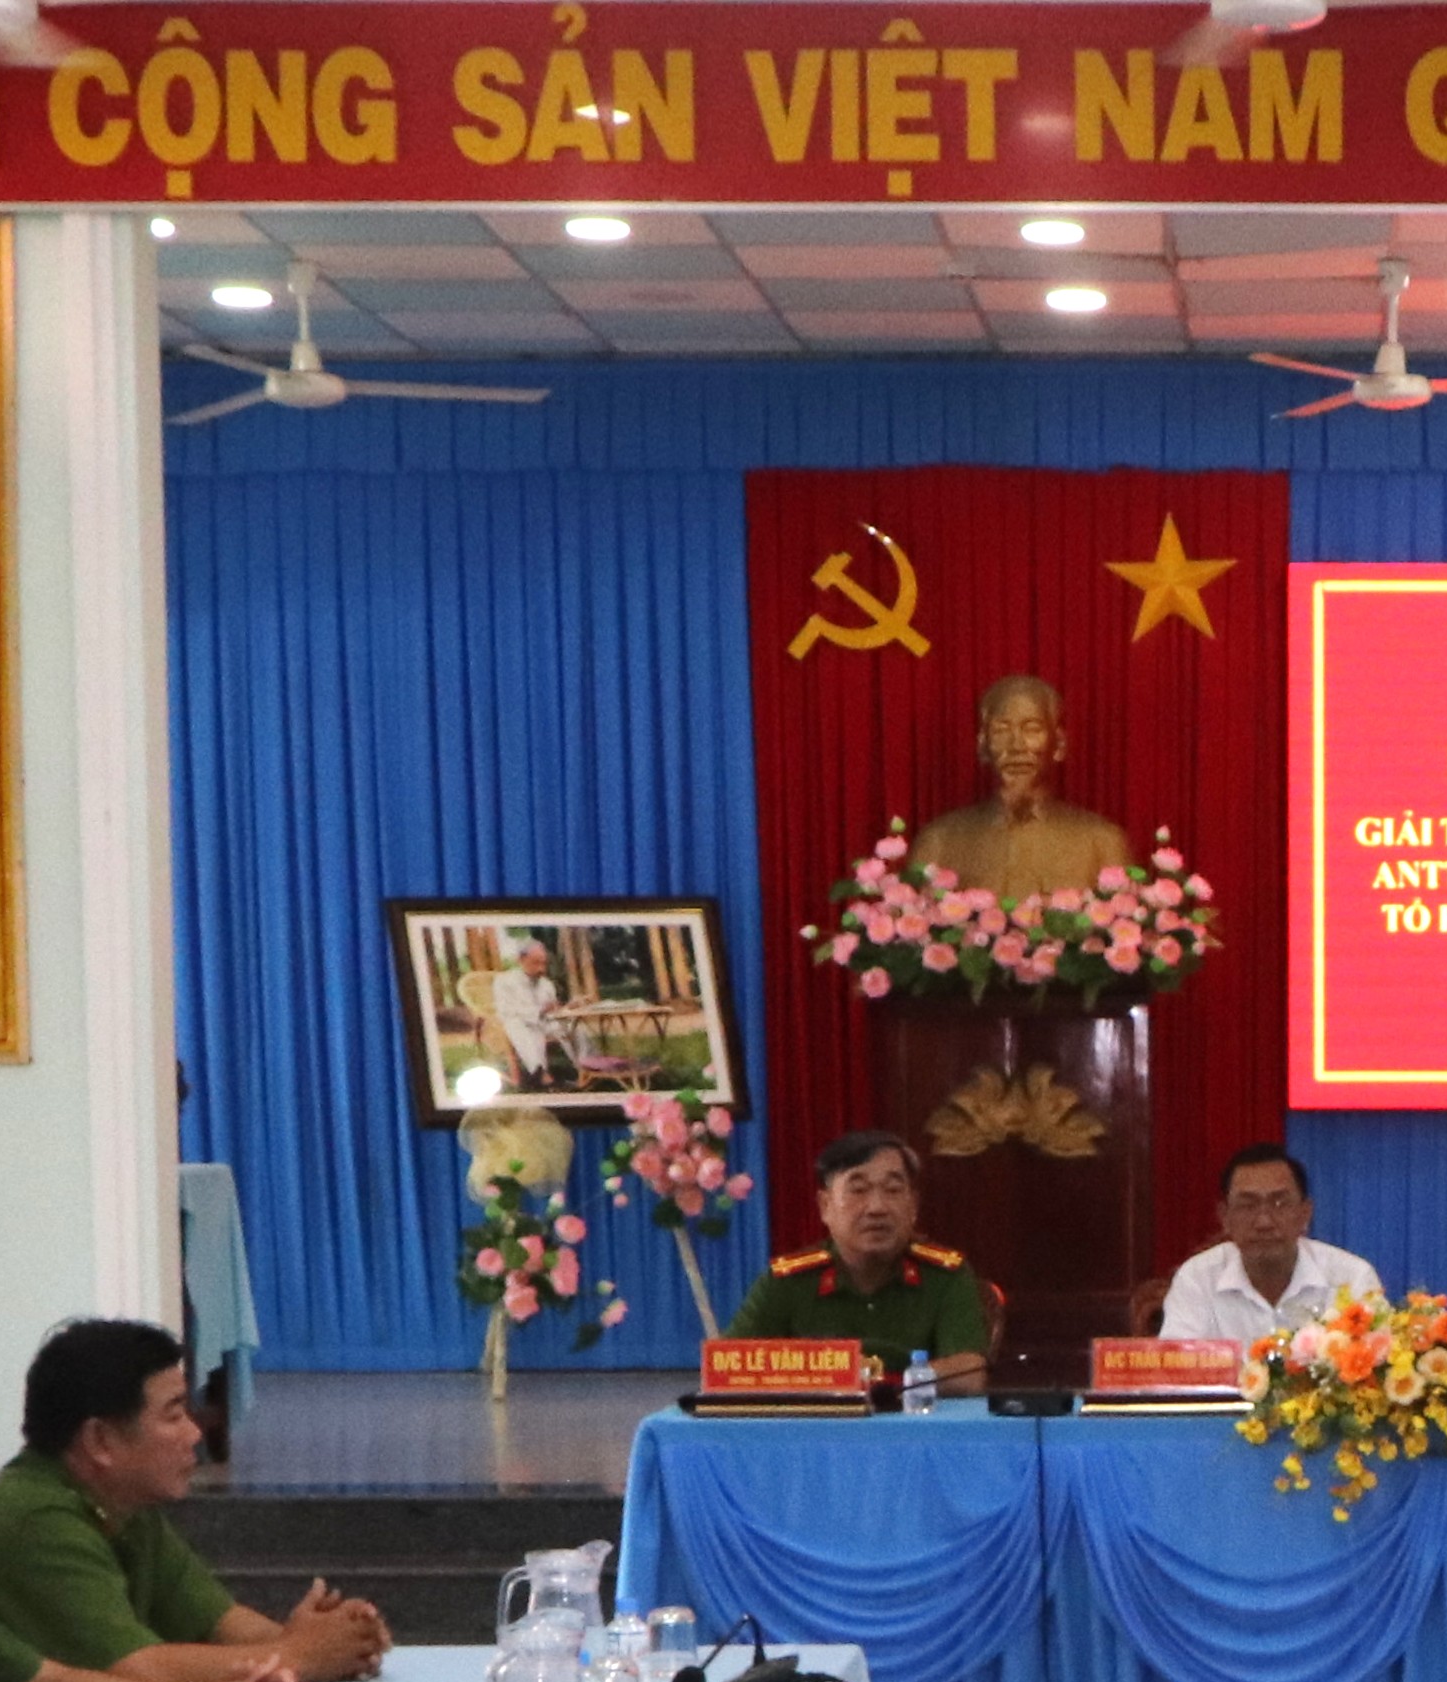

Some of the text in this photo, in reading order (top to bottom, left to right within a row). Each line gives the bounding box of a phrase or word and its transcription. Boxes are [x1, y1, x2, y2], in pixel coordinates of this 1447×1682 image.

[50, 20, 396, 197] CỘNG
[453, 3, 694, 166] SẢN
[746, 19, 1017, 196] VIỆT
[1071, 50, 1342, 161] NAM
[1354, 810, 1433, 847] GIẢI
[1380, 897, 1432, 933] TỔ
